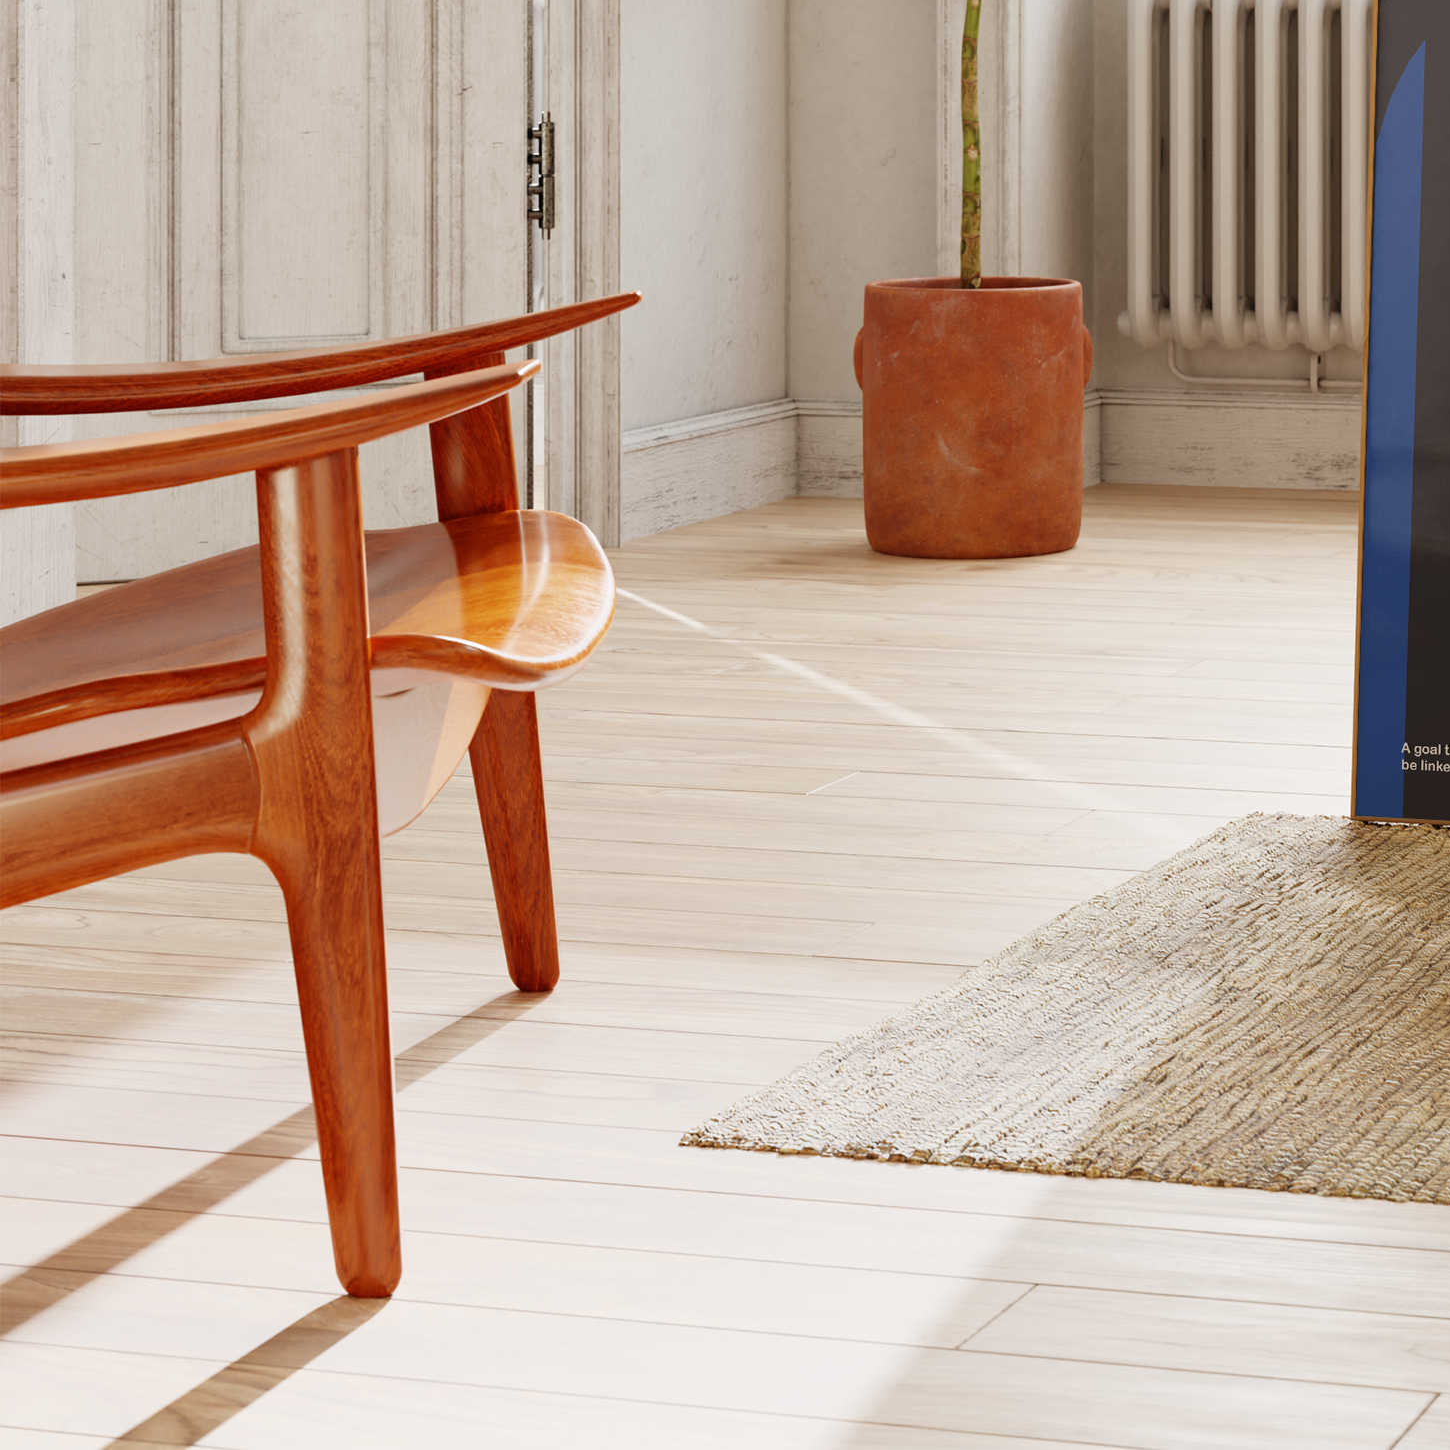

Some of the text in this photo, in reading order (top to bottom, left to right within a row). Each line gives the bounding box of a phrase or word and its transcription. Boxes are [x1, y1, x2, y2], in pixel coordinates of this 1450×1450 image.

[1400, 741, 1411, 754] A
[1413, 743, 1442, 758] goal
[1401, 758, 1418, 771] be
